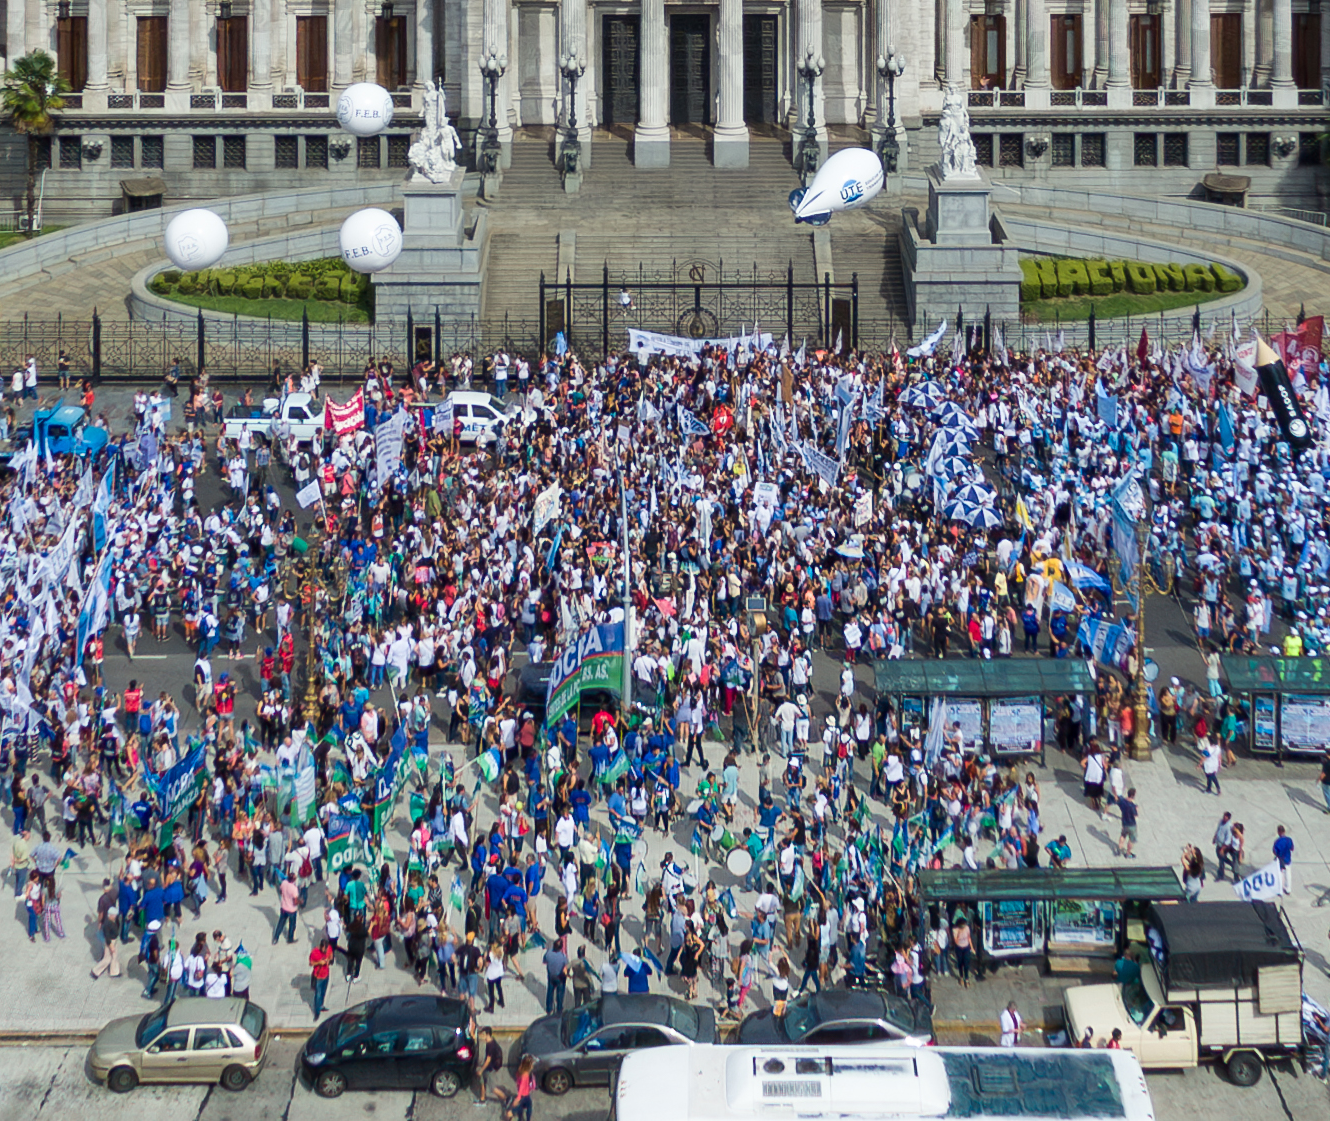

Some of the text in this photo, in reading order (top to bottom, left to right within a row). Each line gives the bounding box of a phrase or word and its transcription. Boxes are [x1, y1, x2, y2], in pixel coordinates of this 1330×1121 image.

[355, 108, 382, 118] F.E.B.
[840, 182, 863, 199] UTE
[344, 245, 374, 260] F.E.B.
[1020, 257, 1245, 301] NACIONAL
